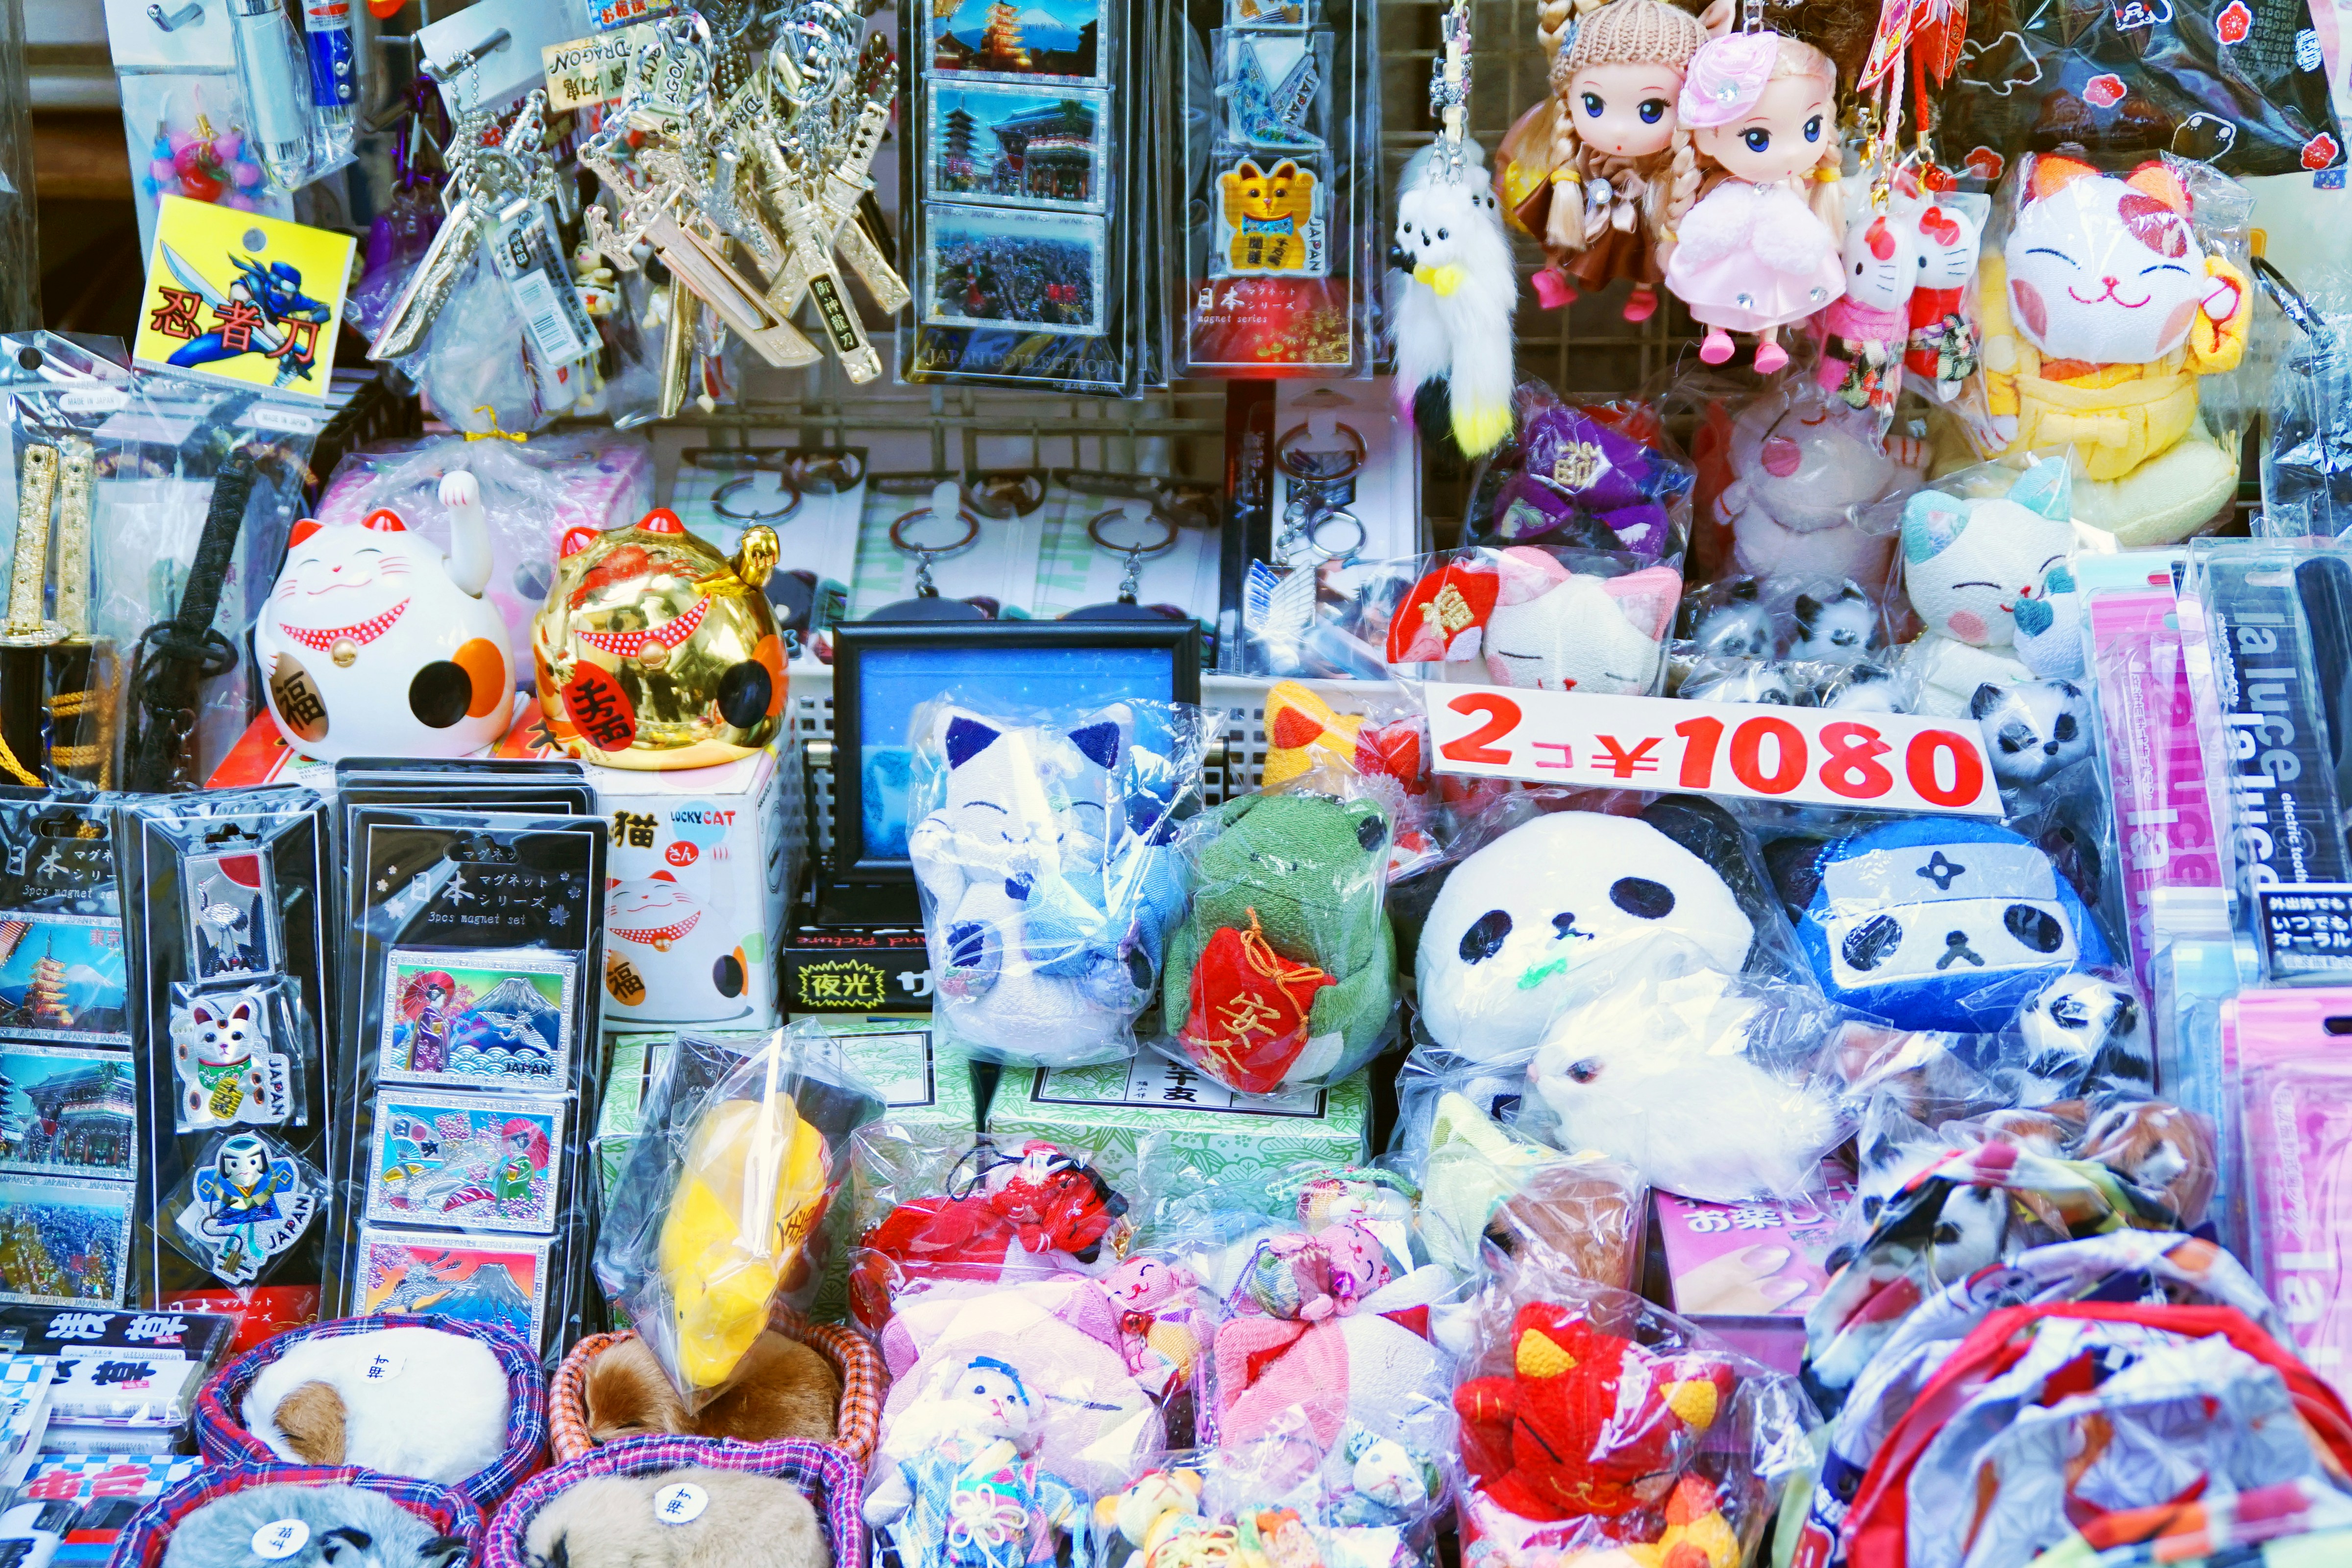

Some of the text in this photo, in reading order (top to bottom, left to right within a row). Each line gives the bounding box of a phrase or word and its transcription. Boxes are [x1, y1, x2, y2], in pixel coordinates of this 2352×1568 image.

[551, 36, 631, 74] DRAGON
[1283, 72, 1318, 124] JAPAN
[1309, 218, 1321, 272] JAPAN
[1197, 286, 1245, 310] 日本
[1247, 288, 1296, 296] マグネット
[1247, 301, 1295, 310] シリーズ
[150, 286, 321, 365] 忍者刀
[1197, 314, 1268, 324] magnet series
[926, 348, 1115, 375] JAPAN COLLECTION
[67, 397, 84, 406] MADE
[96, 396, 115, 405] JAPAN
[262, 413, 279, 422] MADE
[289, 416, 307, 426] JAPAN
[277, 669, 326, 732] 福
[2234, 612, 2301, 783] la luce
[1590, 715, 1985, 808] ¥1080
[610, 809, 660, 849] 猫
[670, 810, 736, 826] LUCKY CAT
[2280, 792, 2299, 846] electric
[2127, 808, 2179, 871] la
[5, 845, 70, 880] 日本
[668, 846, 698, 863] さん
[22, 884, 48, 897] 3pcs
[54, 886, 93, 899] magnet
[410, 870, 475, 906] 日本
[479, 874, 548, 888] マグネット
[479, 894, 547, 908] シリーズ
[2269, 897, 2352, 911] 外出先でも
[427, 911, 526, 926] 3pcs magnet set
[2271, 916, 2352, 931] いつでも
[89, 928, 122, 947] 東京
[796, 934, 877, 947] Picture
[607, 961, 645, 1000] 福
[810, 972, 871, 999] 夜光
[16, 1029, 123, 1042] JAPAN JAPAN JAPAN
[505, 1062, 552, 1075] JAPAN
[268, 1058, 284, 1117] JAPAN
[1163, 1061, 1200, 1103] 干支
[44, 1177, 69, 1186] JAPAN
[89, 1180, 113, 1189] JAPAN
[269, 1196, 310, 1249] JAPAN
[371, 1234, 537, 1250] JAPAN JAPAN JAPAN JAPAN JAPAN
[2276, 1251, 2337, 1323] la
[0, 1292, 98, 1307] PAN JAPAN JAPAN
[220, 1297, 272, 1308] マグネット
[366, 1354, 390, 1379] 押す
[664, 1488, 692, 1515] 押す
[268, 1526, 295, 1552] 押す
